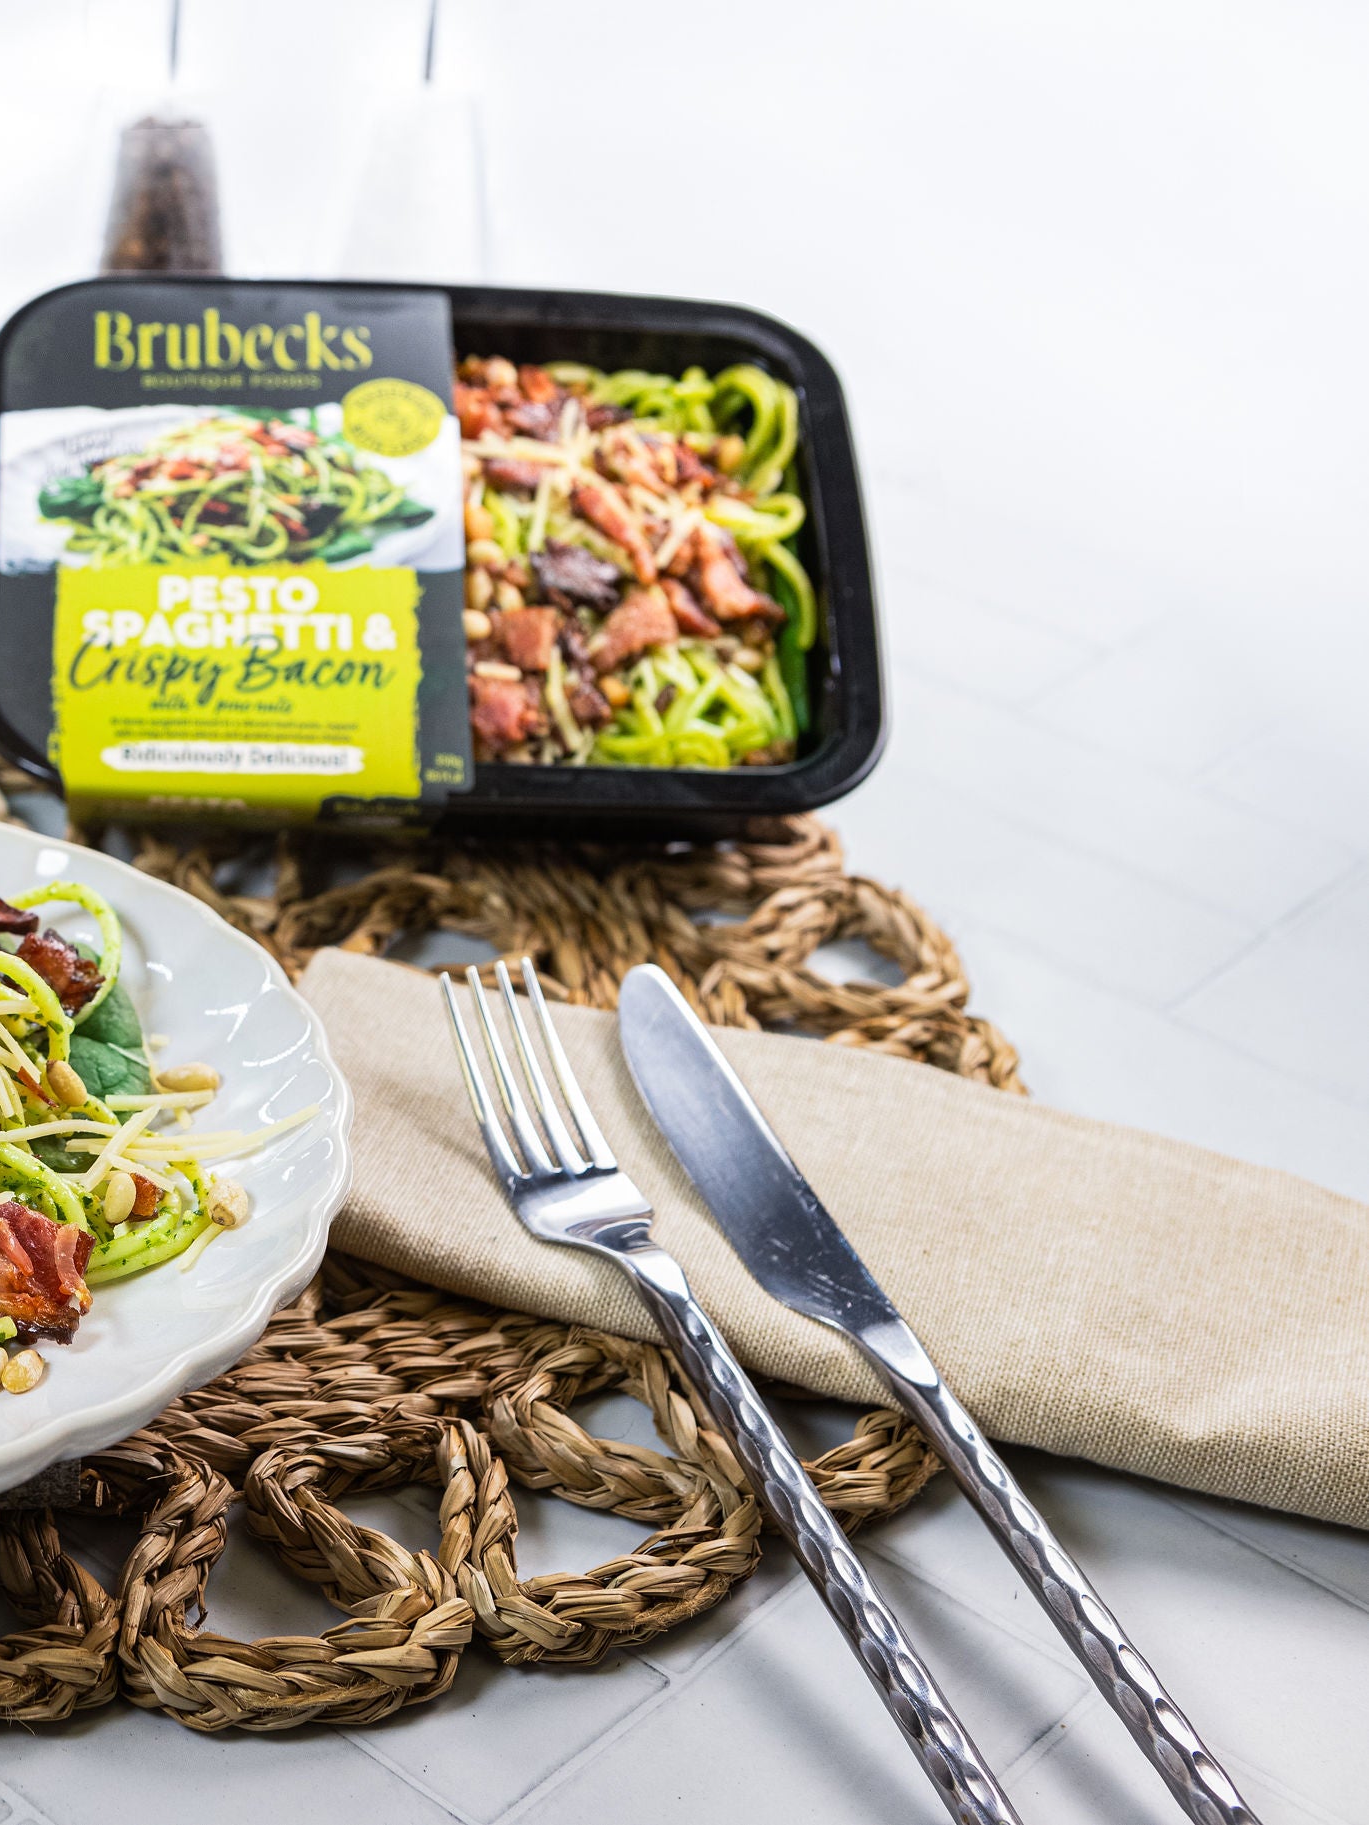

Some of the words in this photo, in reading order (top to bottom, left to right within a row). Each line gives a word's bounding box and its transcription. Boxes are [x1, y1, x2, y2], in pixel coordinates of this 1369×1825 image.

[94, 307, 373, 372] Brubecks
[158, 575, 319, 612] PESTO
[82, 610, 353, 651] SPAGHETTI
[362, 613, 397, 651] &
[69, 632, 231, 706] Crispy
[234, 634, 395, 693] Bacon
[121, 745, 242, 769] Ridiculously
[249, 748, 349, 769] Delicious!
